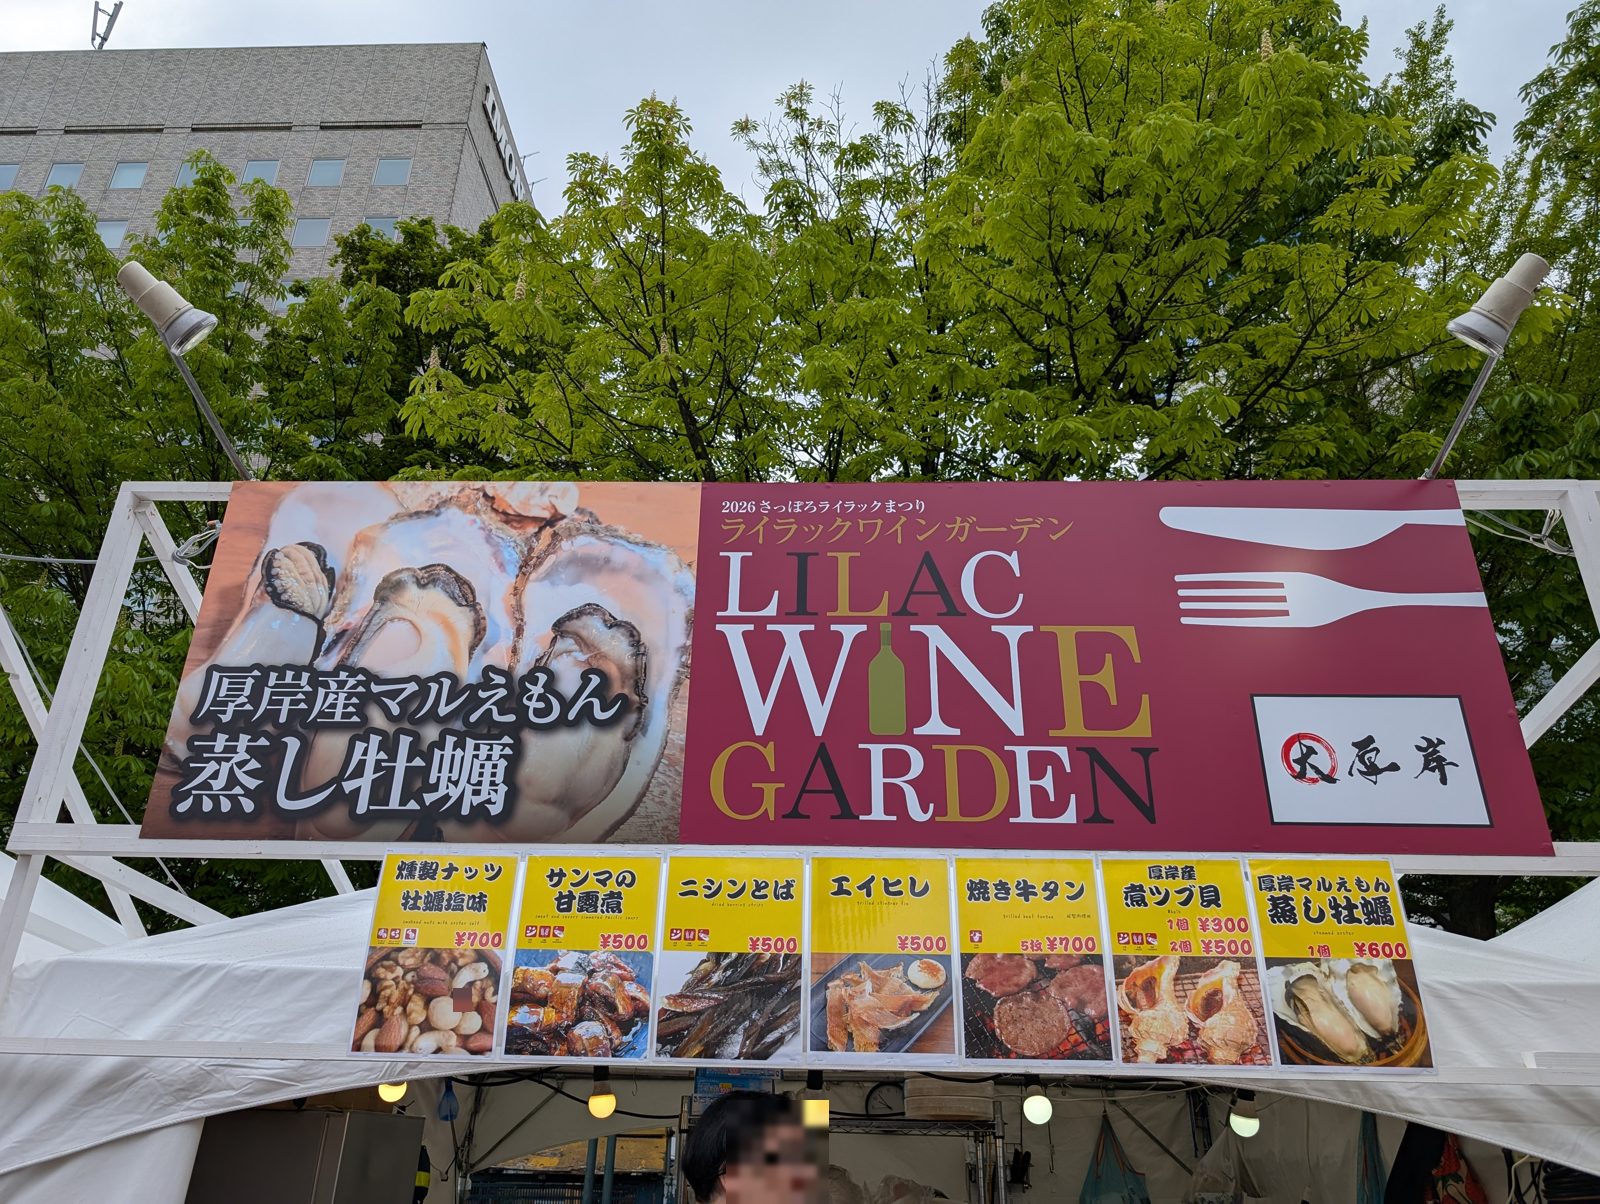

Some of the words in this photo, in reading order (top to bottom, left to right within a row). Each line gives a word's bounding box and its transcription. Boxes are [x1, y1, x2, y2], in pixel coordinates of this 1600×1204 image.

[721, 500, 756, 514] 2026
[759, 499, 926, 514] さっぽろライラックまつり
[720, 515, 1075, 545] ライラックワインガーデン
[715, 550, 1024, 619] LILAC
[196, 668, 623, 725] 厚岸産マルえもん
[175, 733, 515, 817] 蒸し牡蠣
[709, 741, 1159, 825] GARDEN
[396, 859, 504, 882] 燻製ナッツ
[544, 867, 638, 890] サンマの
[1147, 864, 1198, 881] 厚岸産
[677, 877, 797, 901] ニシンとば
[966, 877, 1087, 902] 焼き牛タン
[1256, 873, 1392, 894] 厚岸マルえもん
[400, 889, 489, 913] 牡蠣塩味
[553, 889, 625, 914] 甘露煮
[1122, 882, 1223, 909] 煮ツブ貝
[1266, 893, 1396, 927] 蒸し牡蠣
[1167, 918, 1190, 931] 1個
[1198, 916, 1250, 933] ¥300
[454, 930, 503, 948] ¥700
[599, 932, 649, 950] ¥500
[747, 936, 798, 953] ¥500
[897, 935, 948, 952] ¥500
[1020, 939, 1043, 953] 5枚
[1046, 936, 1097, 953] ¥700
[1169, 939, 1193, 954] 2個
[1201, 938, 1254, 955] ¥500
[1308, 944, 1332, 958] 1個
[1353, 941, 1408, 959] ¥600
